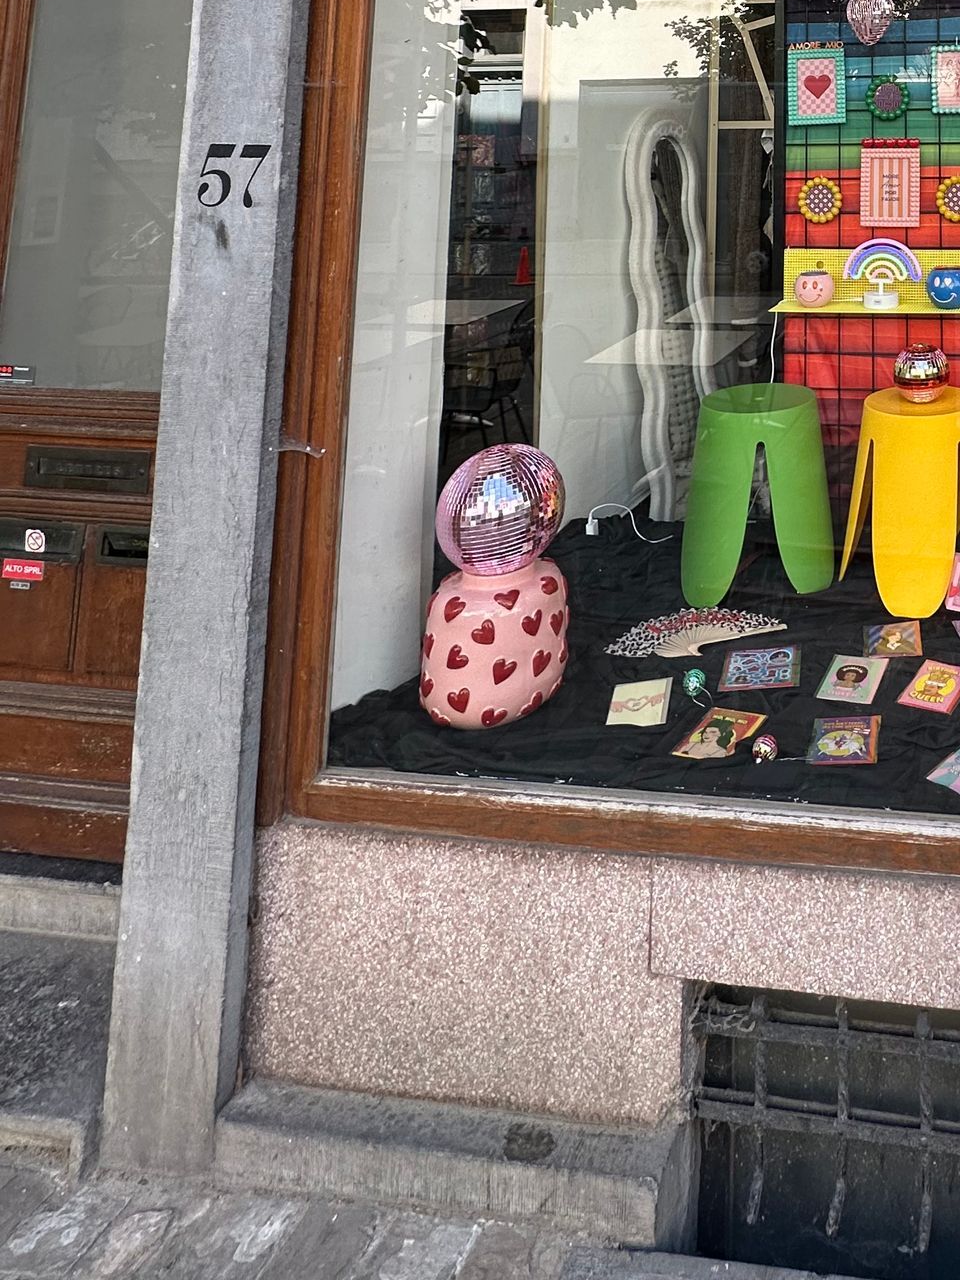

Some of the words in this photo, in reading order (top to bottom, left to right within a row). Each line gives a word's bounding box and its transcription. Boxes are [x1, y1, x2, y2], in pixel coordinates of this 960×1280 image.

[788, 41, 821, 51] AMORE
[825, 40, 844, 50] MIO
[197, 142, 272, 209] 57
[4, 564, 23, 573] ALTO
[23, 565, 42, 575] SPRL
[909, 690, 945, 704] QUEEN
